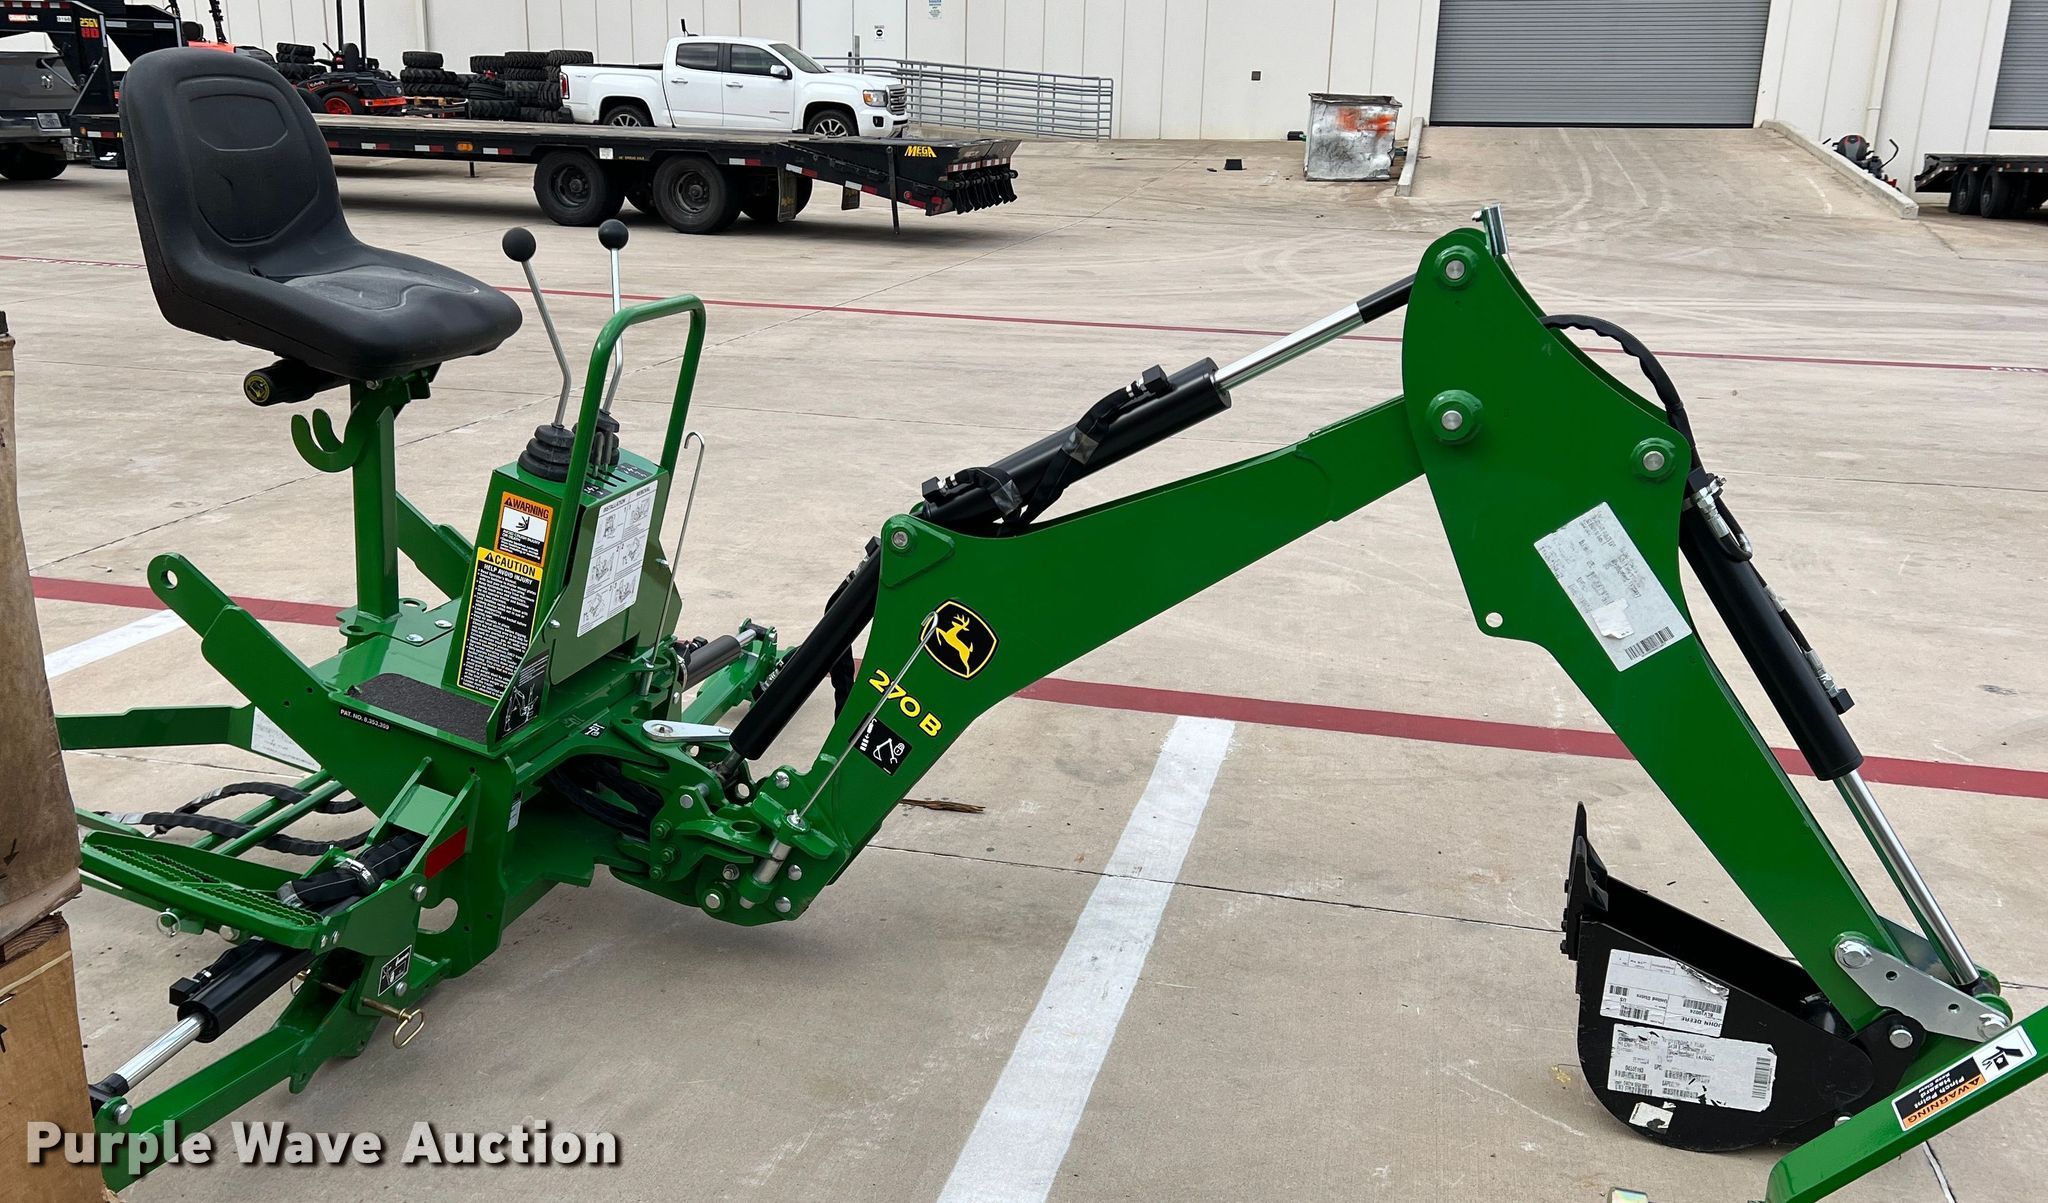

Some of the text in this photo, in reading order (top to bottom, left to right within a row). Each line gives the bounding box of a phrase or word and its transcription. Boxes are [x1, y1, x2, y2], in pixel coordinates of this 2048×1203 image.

[904, 146, 937, 158] MEGA
[513, 498, 549, 519] WARNING
[495, 555, 536, 576] CAUTION
[868, 669, 921, 718] 270
[1680, 1016, 1722, 1028] JOHN DEERE
[1914, 1076, 1965, 1109] Pinch Point
[1920, 1078, 1951, 1098] Hazard
[1908, 1085, 1970, 1122] WARNING
